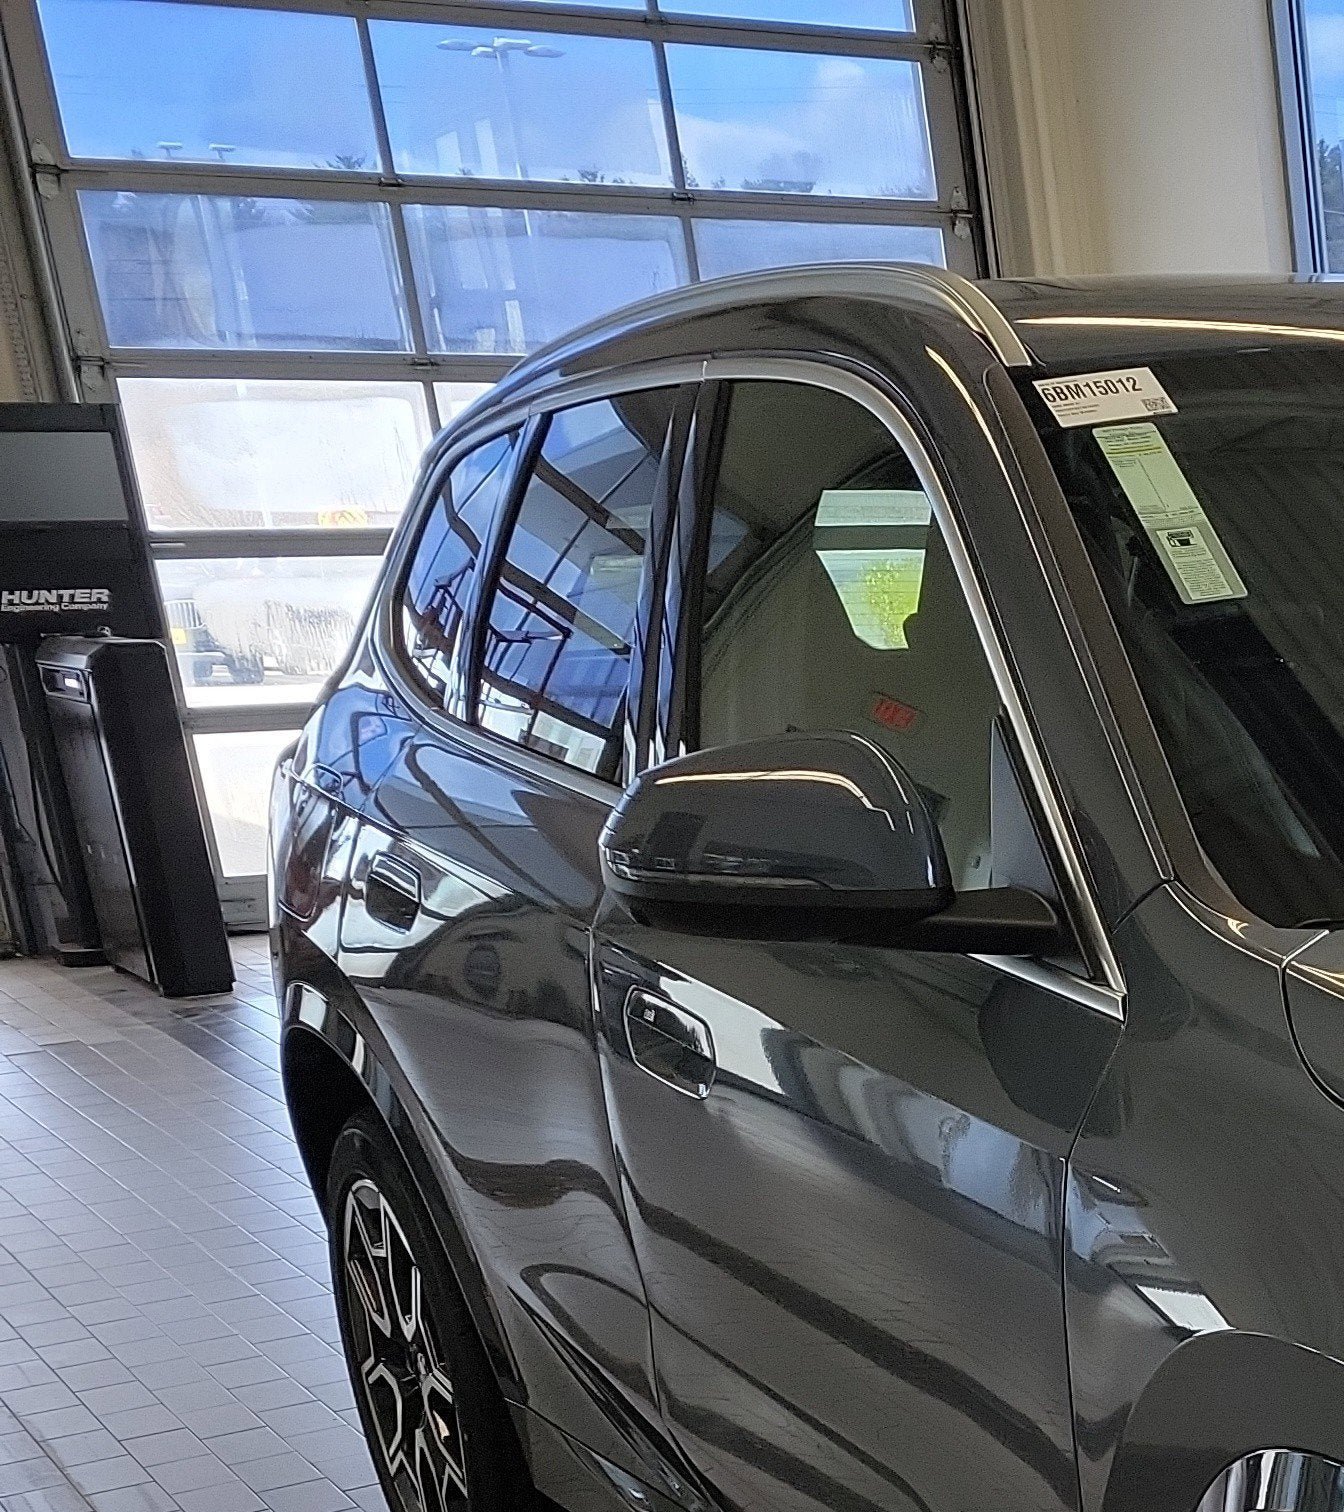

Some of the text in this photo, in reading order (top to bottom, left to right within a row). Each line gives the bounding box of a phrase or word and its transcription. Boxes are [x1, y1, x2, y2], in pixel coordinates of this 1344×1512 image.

[1041, 375, 1142, 404] 6BM15012
[1, 588, 112, 604] HUNTER
[61, 602, 109, 611] Company
